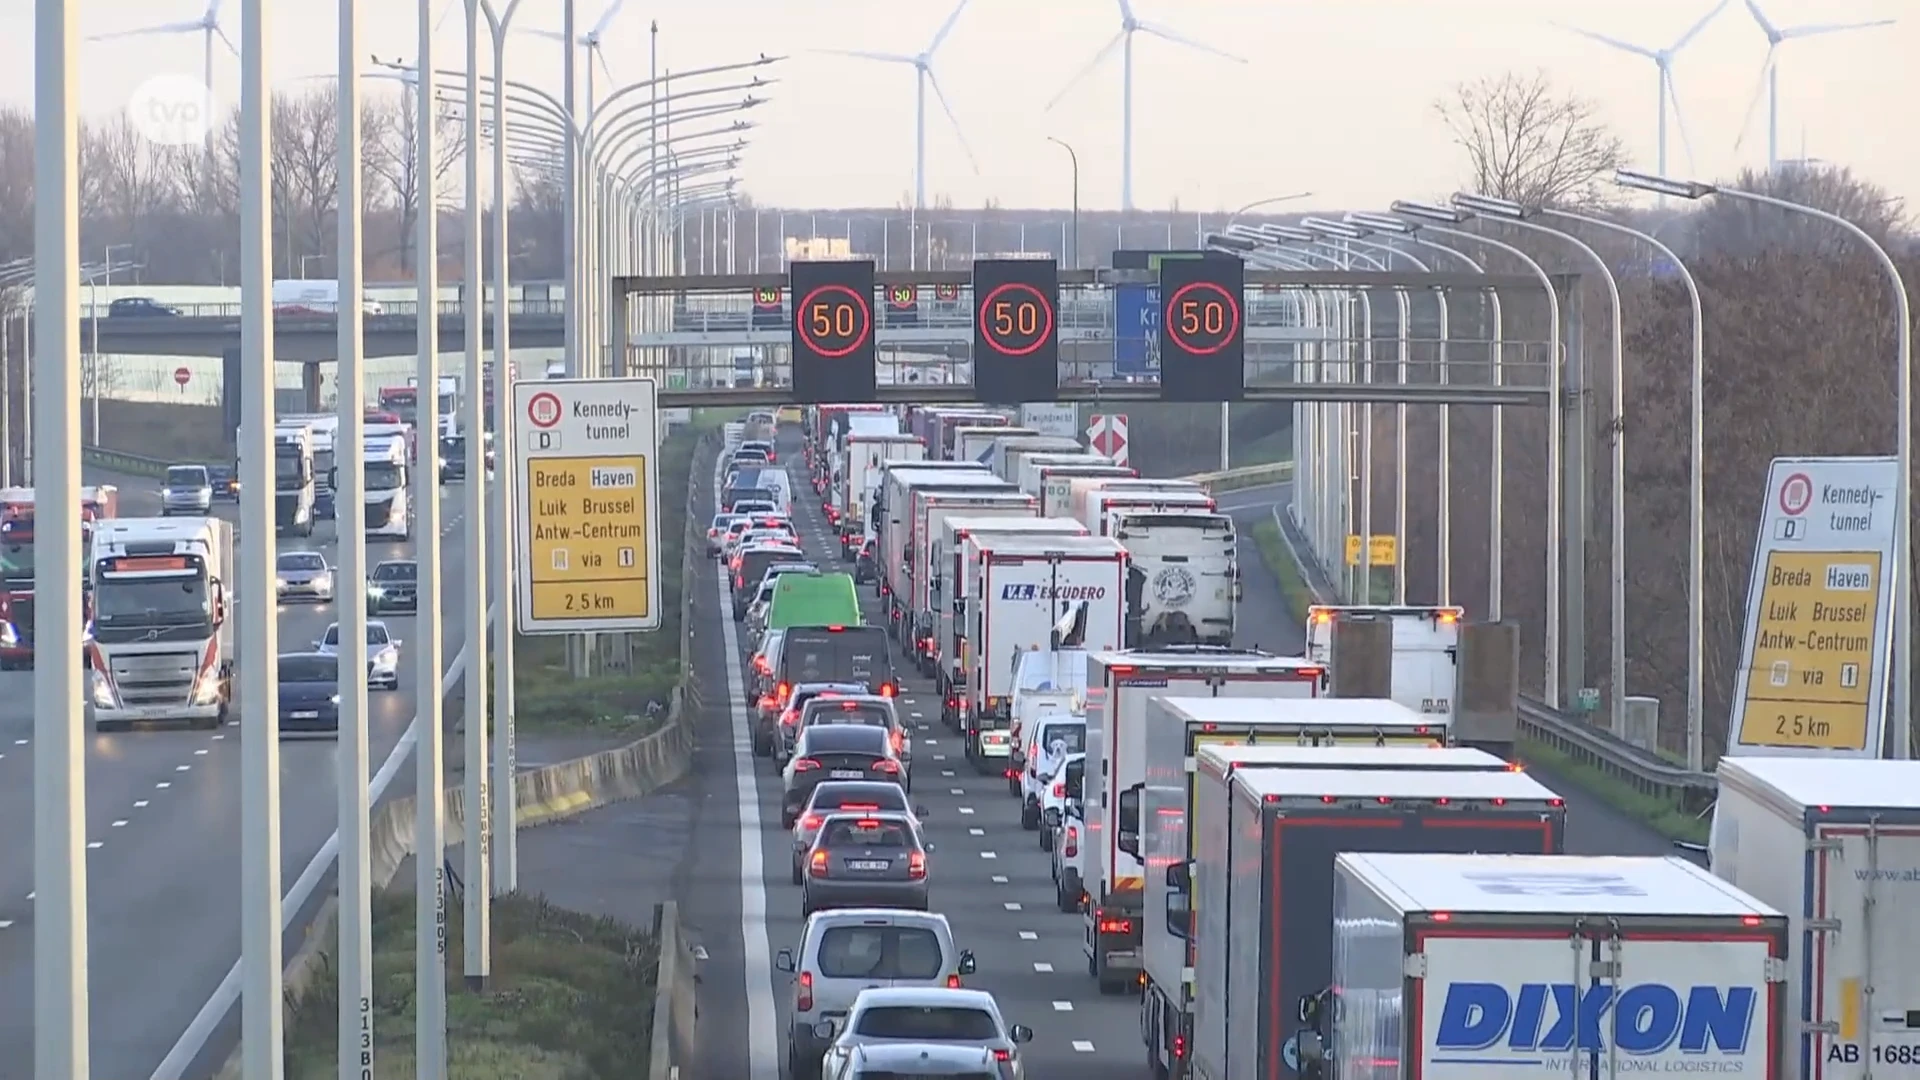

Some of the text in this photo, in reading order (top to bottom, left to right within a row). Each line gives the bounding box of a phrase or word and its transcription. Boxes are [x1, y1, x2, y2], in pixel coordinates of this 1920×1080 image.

[812, 304, 854, 337] 50
[993, 303, 1037, 336] 50
[1181, 301, 1223, 334] 50
[573, 401, 639, 420] Kennedy-
[540, 432, 551, 449] D
[586, 423, 630, 440] tunnel
[536, 469, 634, 487] Breda Haven
[1822, 484, 1884, 508] Kennedy-
[539, 497, 635, 516] Luik Brussel
[535, 522, 641, 540] Antw.-Centrum
[1784, 520, 1796, 538] D
[1830, 512, 1872, 531] tunnel
[582, 550, 630, 568] via 1
[1771, 565, 1870, 588] Breda Haven
[594, 592, 614, 609] km
[1040, 585, 1106, 600] ESCUDERO
[1769, 600, 1867, 623] Luik Brussel
[1759, 630, 1868, 651] Antw.-Centrum
[1802, 666, 1853, 685] via 1
[1808, 715, 1831, 737] km
[436, 867, 445, 954] 313B05
[1436, 982, 1757, 1055] DIXON
[1827, 1044, 1860, 1064] AB
[1664, 1060, 1744, 1074] LOGISTICS
